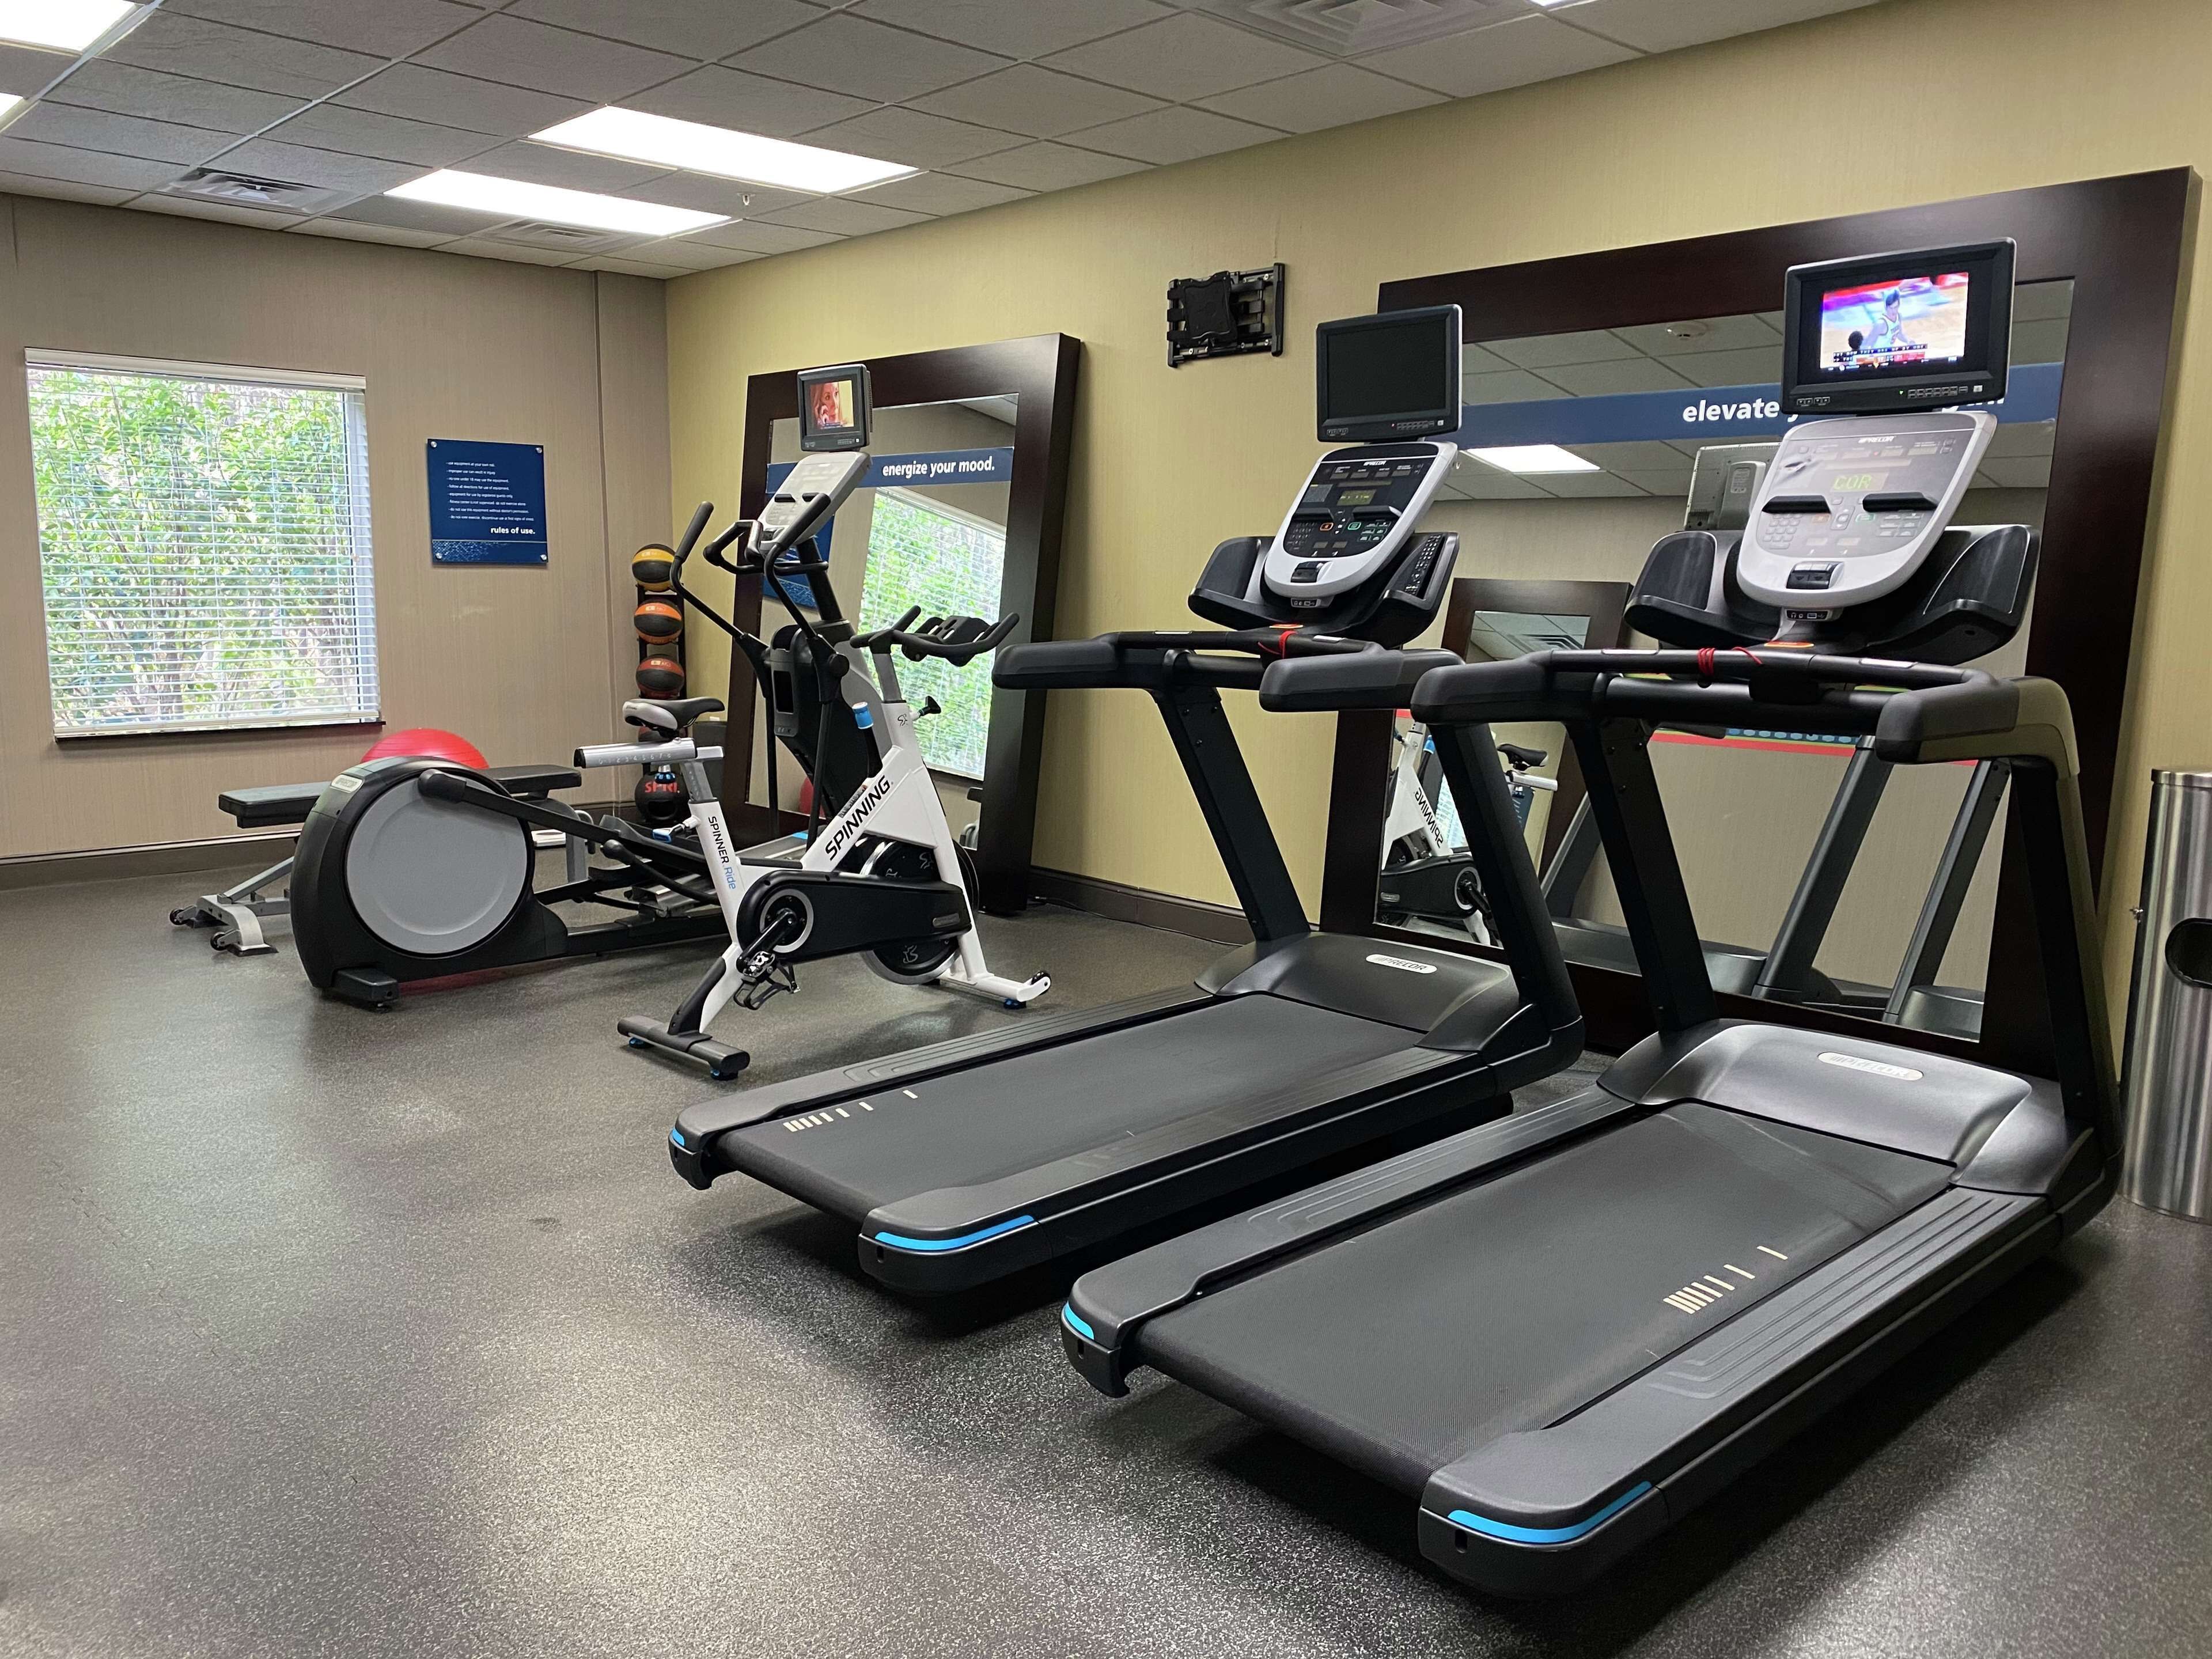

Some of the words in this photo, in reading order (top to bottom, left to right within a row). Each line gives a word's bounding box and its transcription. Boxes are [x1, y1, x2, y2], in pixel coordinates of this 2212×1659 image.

[1683, 398, 1780, 422] elevate
[882, 461, 927, 479] energize
[930, 462, 956, 478] your
[959, 456, 995, 472] mood.
[825, 775, 891, 861] SPINNING
[708, 816, 729, 863] SPINNER
[724, 866, 736, 889] Ride
[1382, 957, 1427, 971] PRECOR
[1841, 1056, 1908, 1078] PRECOR
